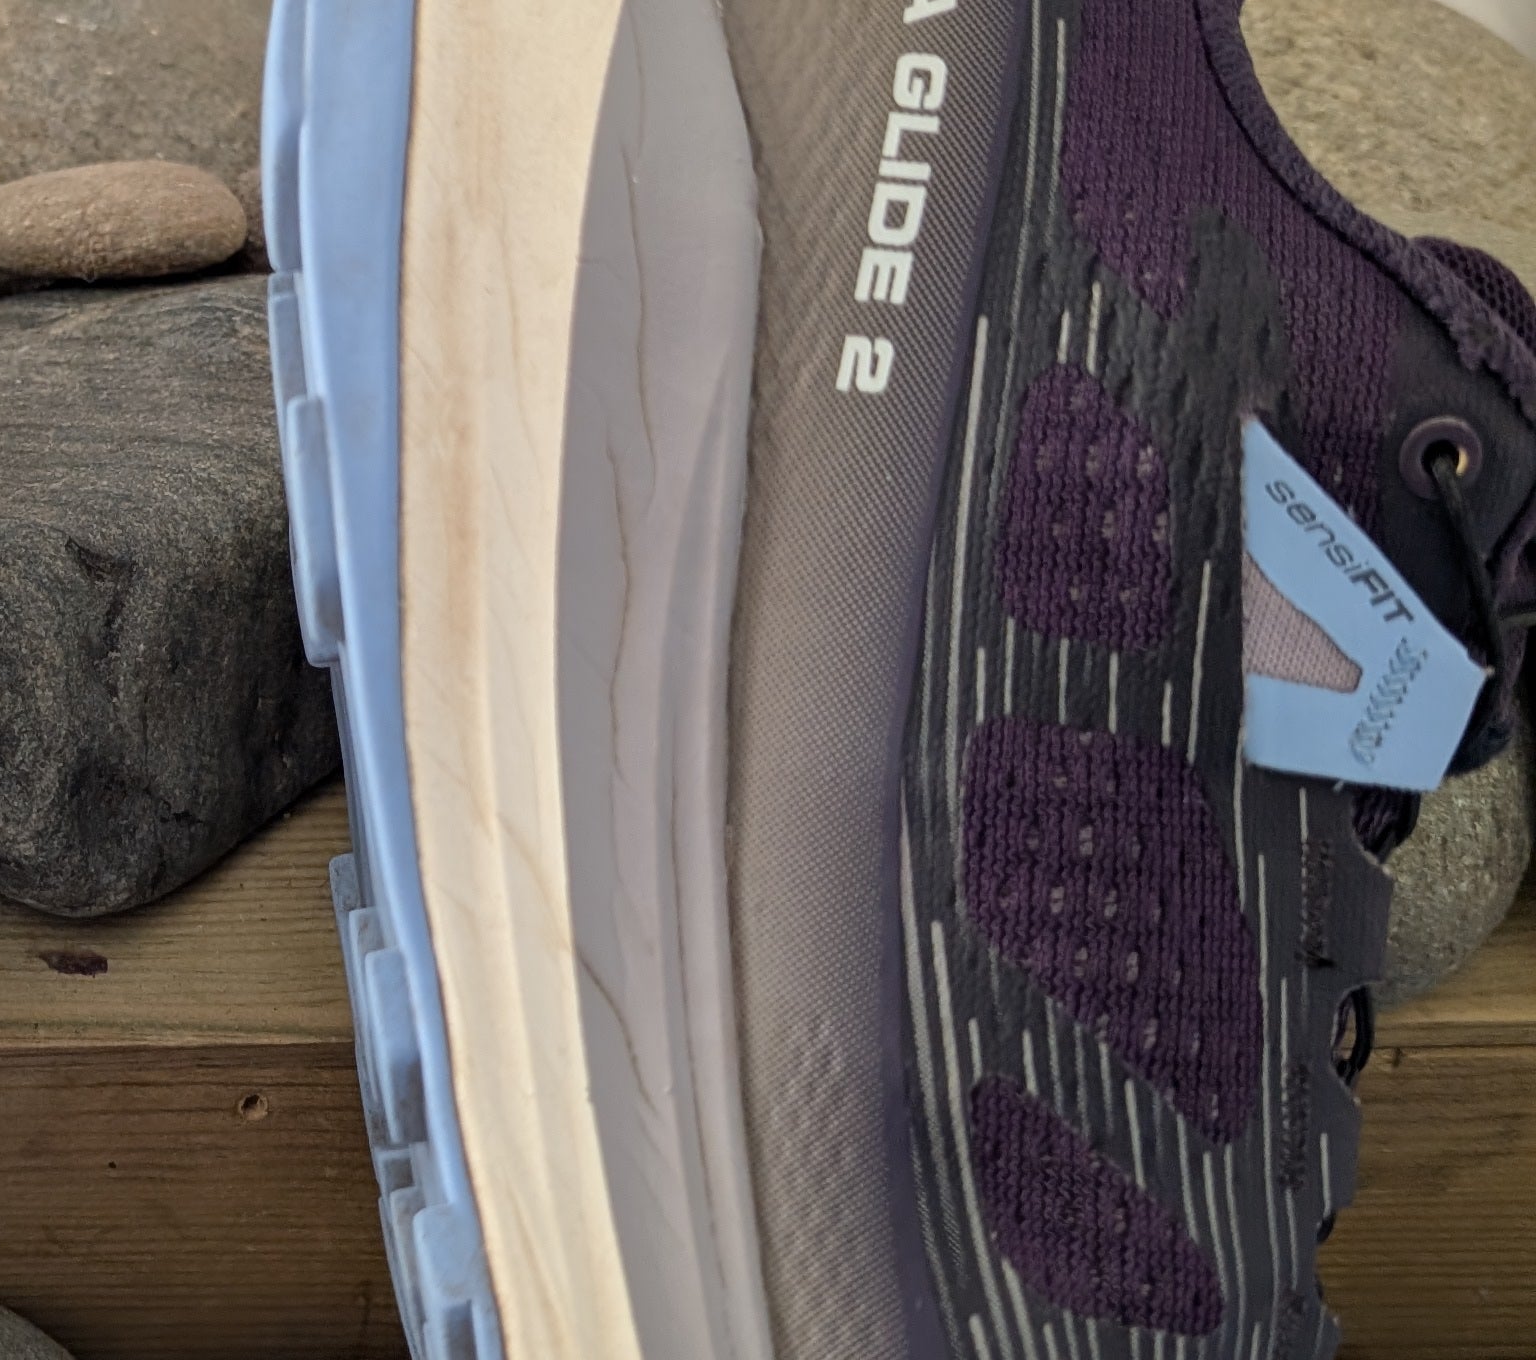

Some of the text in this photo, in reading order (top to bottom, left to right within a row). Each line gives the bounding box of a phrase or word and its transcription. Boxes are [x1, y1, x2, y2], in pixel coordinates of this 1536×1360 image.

[854, 52, 948, 305] GLIDE
[835, 334, 895, 395] 2
[1265, 479, 1415, 625] sensiFIT
